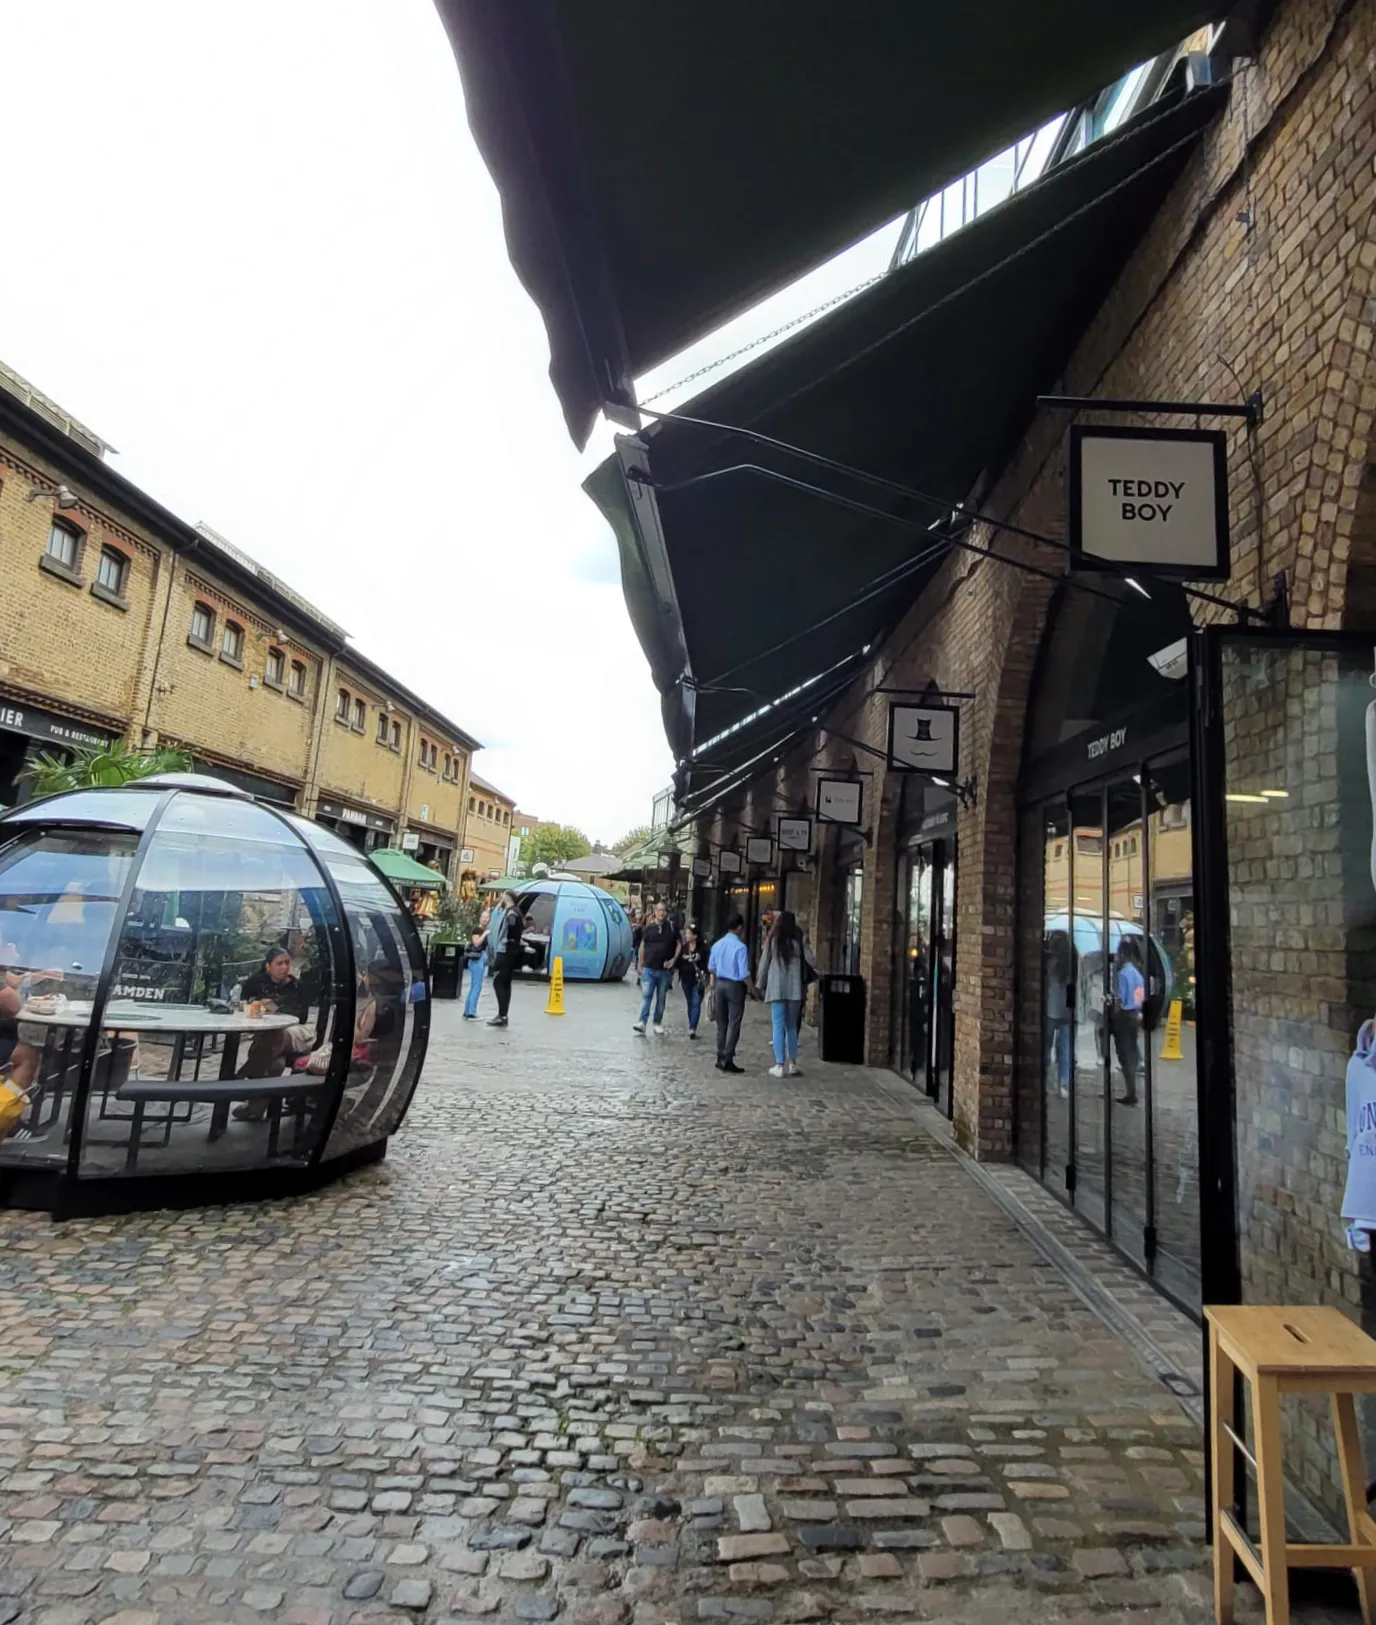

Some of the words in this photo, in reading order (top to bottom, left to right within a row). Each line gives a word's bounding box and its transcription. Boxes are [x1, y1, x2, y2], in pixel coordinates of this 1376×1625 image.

[1107, 479, 1186, 499] TEDDY
[1122, 502, 1173, 522] BOY
[0, 707, 24, 727] IER
[50, 725, 63, 736] PUB
[1087, 734, 1110, 760] TEDDY
[1110, 726, 1128, 750] BOY
[112, 984, 165, 999] AMDEN
[1359, 1144, 1376, 1157] EN
